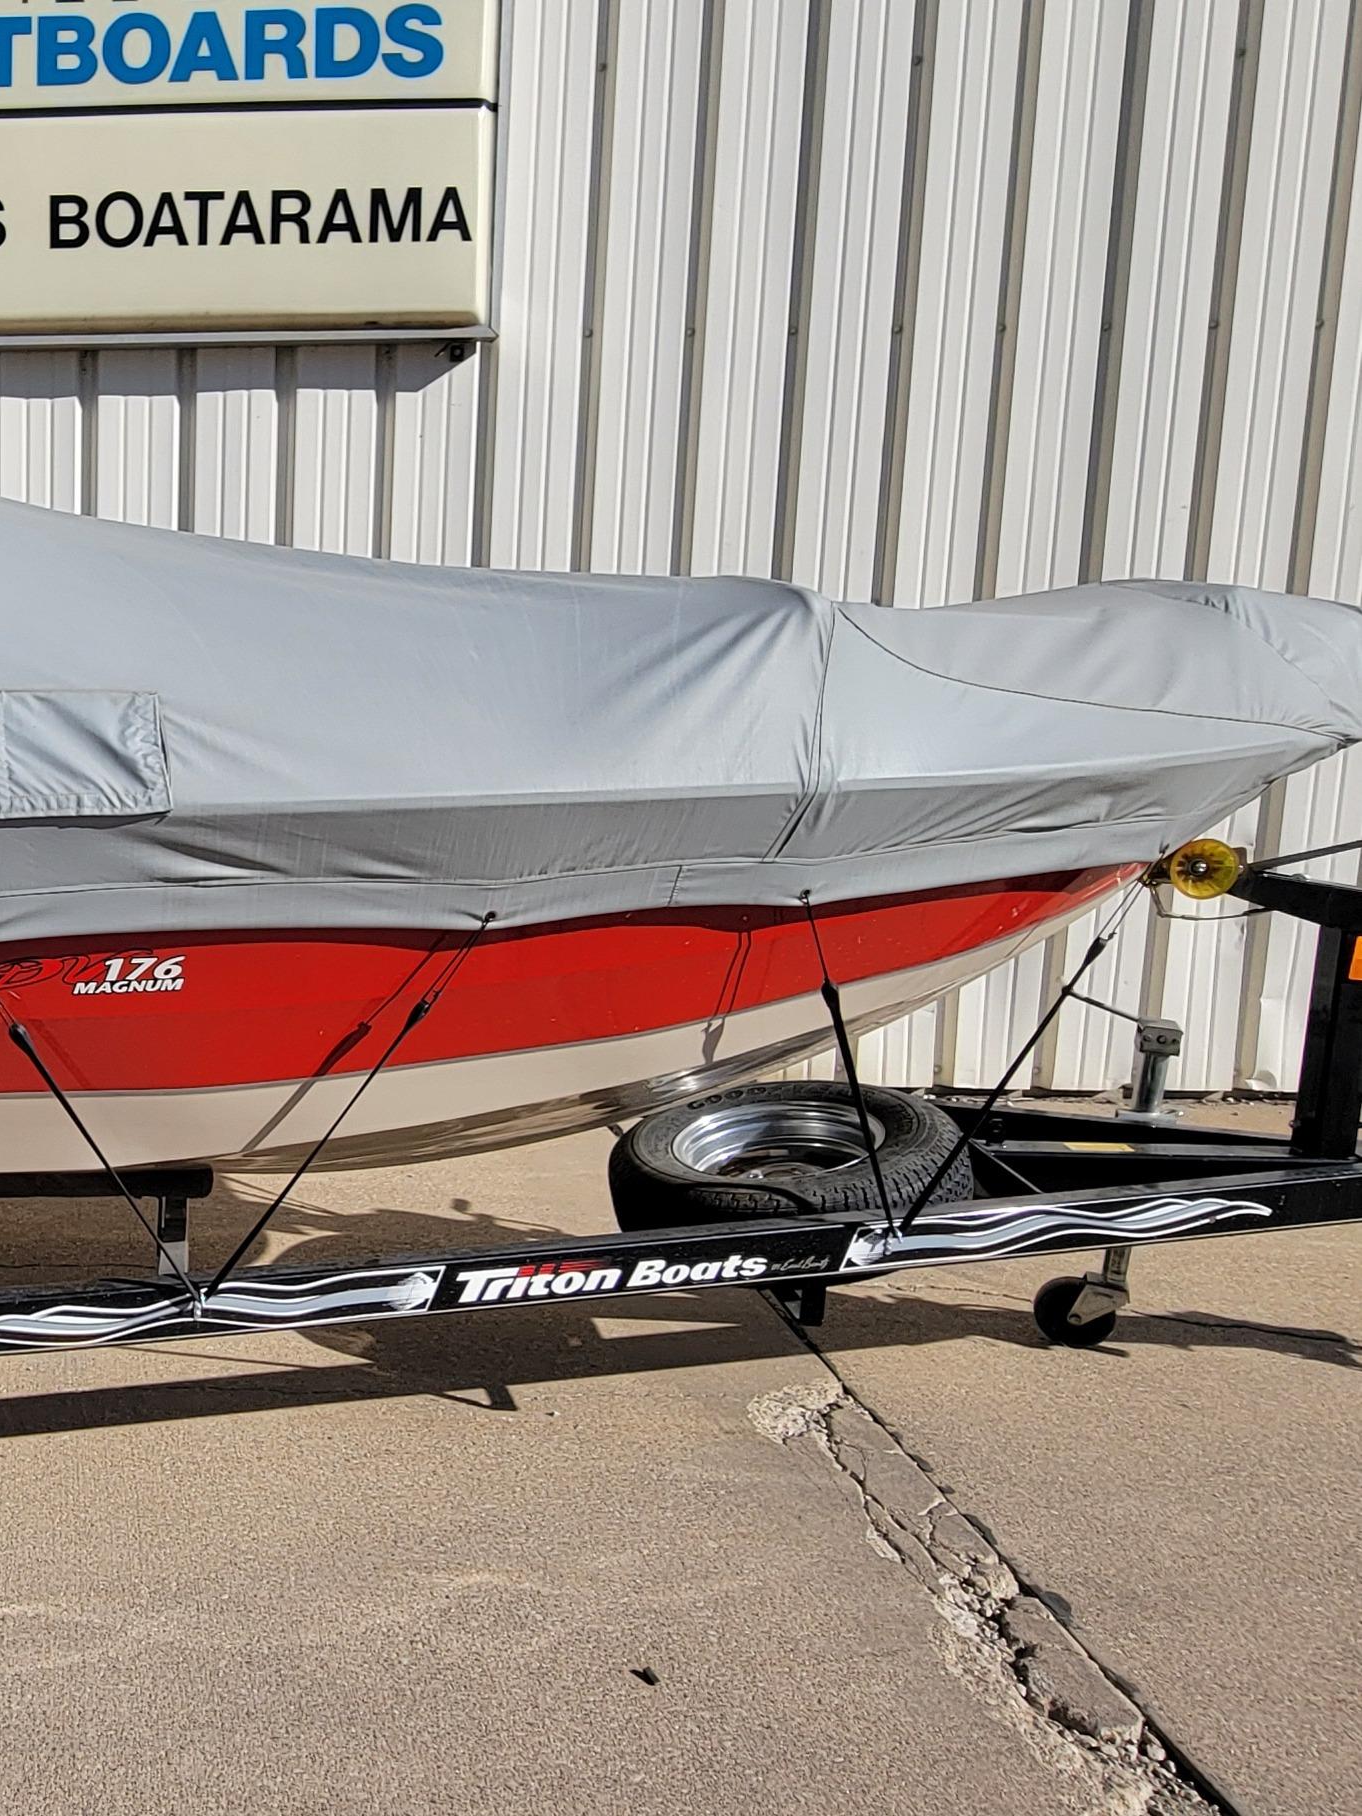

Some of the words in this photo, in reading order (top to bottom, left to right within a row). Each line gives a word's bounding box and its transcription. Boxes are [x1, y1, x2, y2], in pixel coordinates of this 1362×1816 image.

[48, 186, 473, 249] BOATARAMA
[72, 978, 185, 995] MAGNUM
[104, 955, 187, 981] 176
[455, 1263, 623, 1304] Triton
[627, 1254, 769, 1288] Boats
